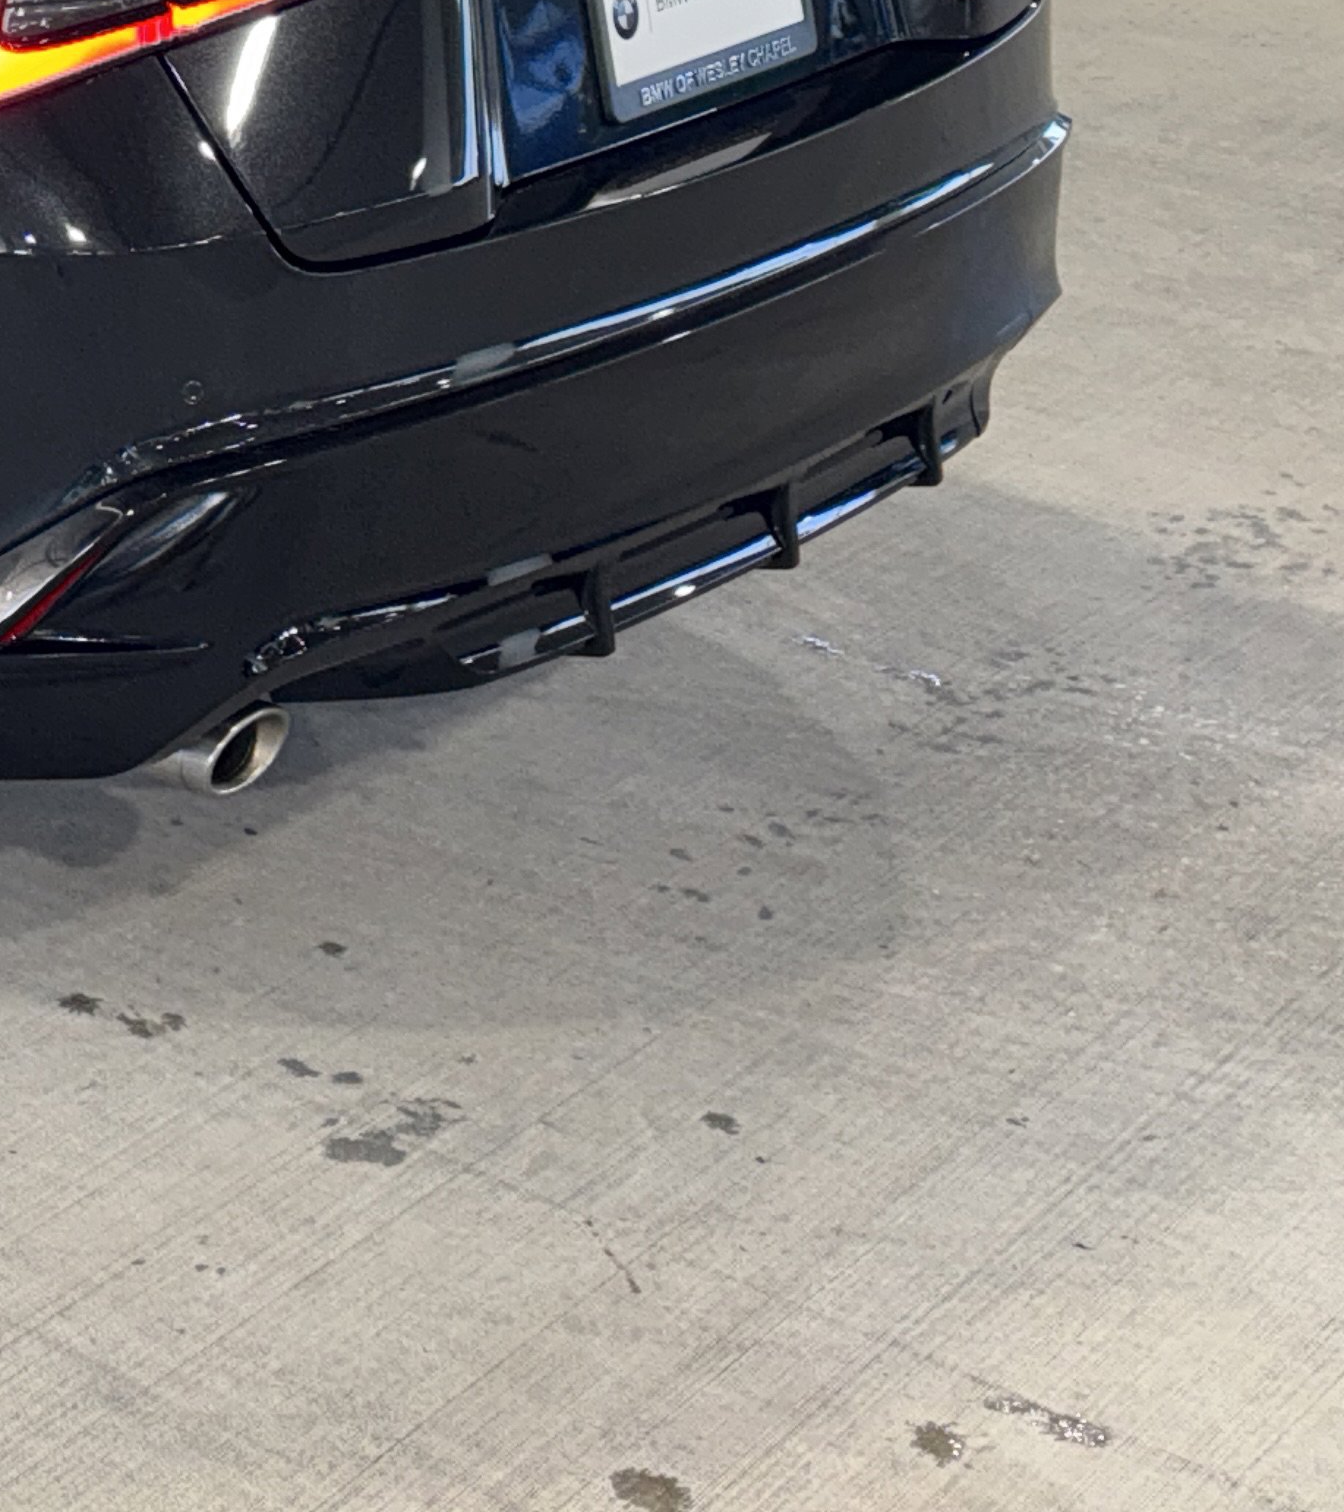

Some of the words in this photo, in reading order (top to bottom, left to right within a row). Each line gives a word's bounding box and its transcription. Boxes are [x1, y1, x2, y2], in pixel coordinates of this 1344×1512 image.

[640, 77, 674, 106] BMW
[675, 71, 695, 94] OF
[695, 52, 745, 85] WESLEY
[747, 35, 798, 67] CHAPEL
